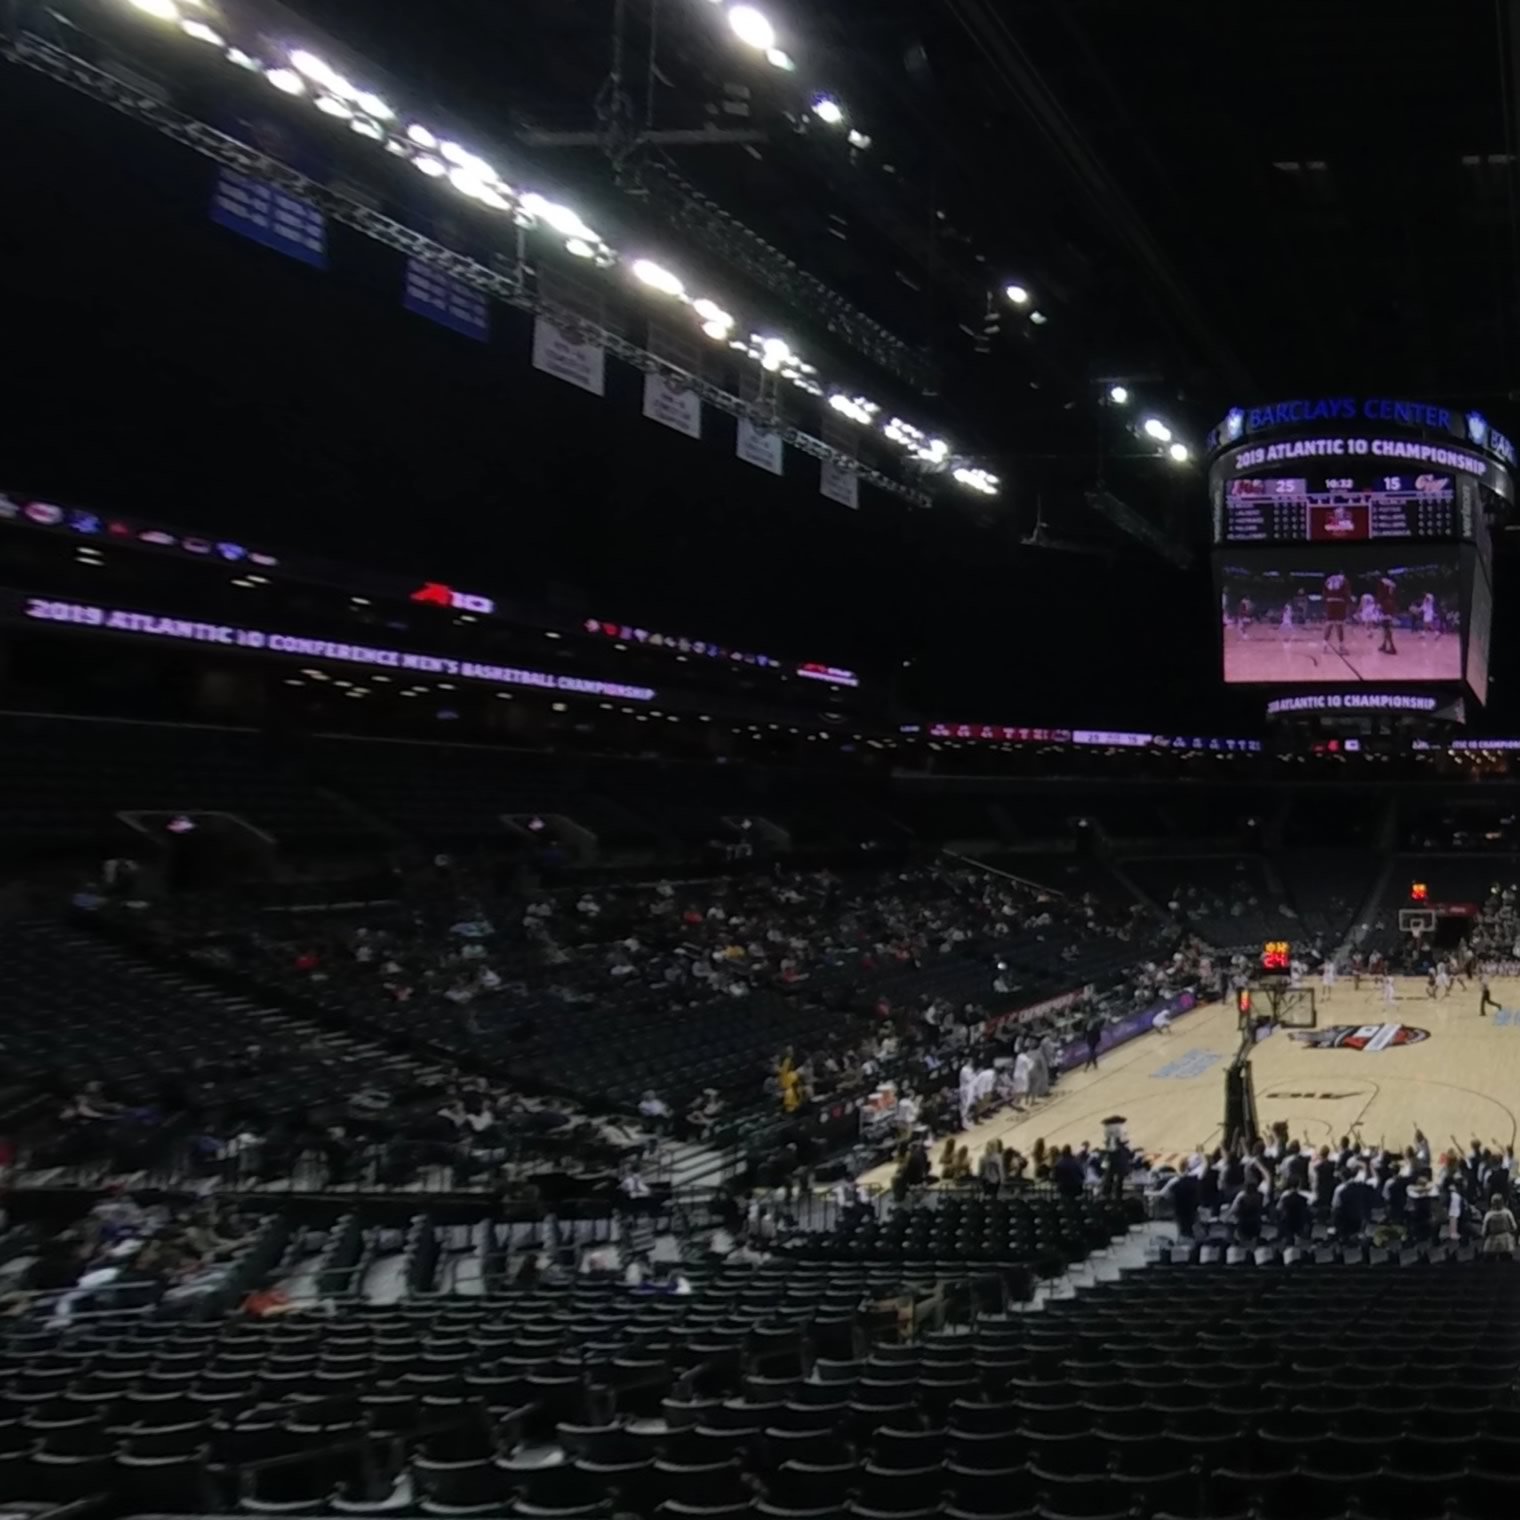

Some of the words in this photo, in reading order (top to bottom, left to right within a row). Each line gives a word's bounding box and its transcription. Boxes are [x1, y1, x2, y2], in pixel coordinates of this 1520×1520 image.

[1250, 399, 1355, 428] BARCLAYS
[1363, 399, 1450, 428] CENTER
[1236, 447, 1265, 469] 2019
[1266, 439, 1344, 462] ATLANTIC
[1346, 439, 1368, 454] 10
[1370, 440, 1486, 476] CHAMPIONSHIP
[1275, 479, 1295, 493] 25
[1383, 476, 1401, 490] 15
[26, 599, 104, 625] 2019
[105, 611, 233, 644] ATLANTIC
[237, 629, 264, 647] 10
[268, 634, 399, 667] CONFERENCE
[402, 653, 459, 674] MEN'S
[461, 662, 556, 688] BASKETBALL
[557, 676, 656, 700] CHAMPIONSHIP
[1280, 696, 1326, 711] ATLANTIC
[1327, 694, 1342, 707] 10
[1343, 694, 1437, 710] CHAMPIONSHIP
